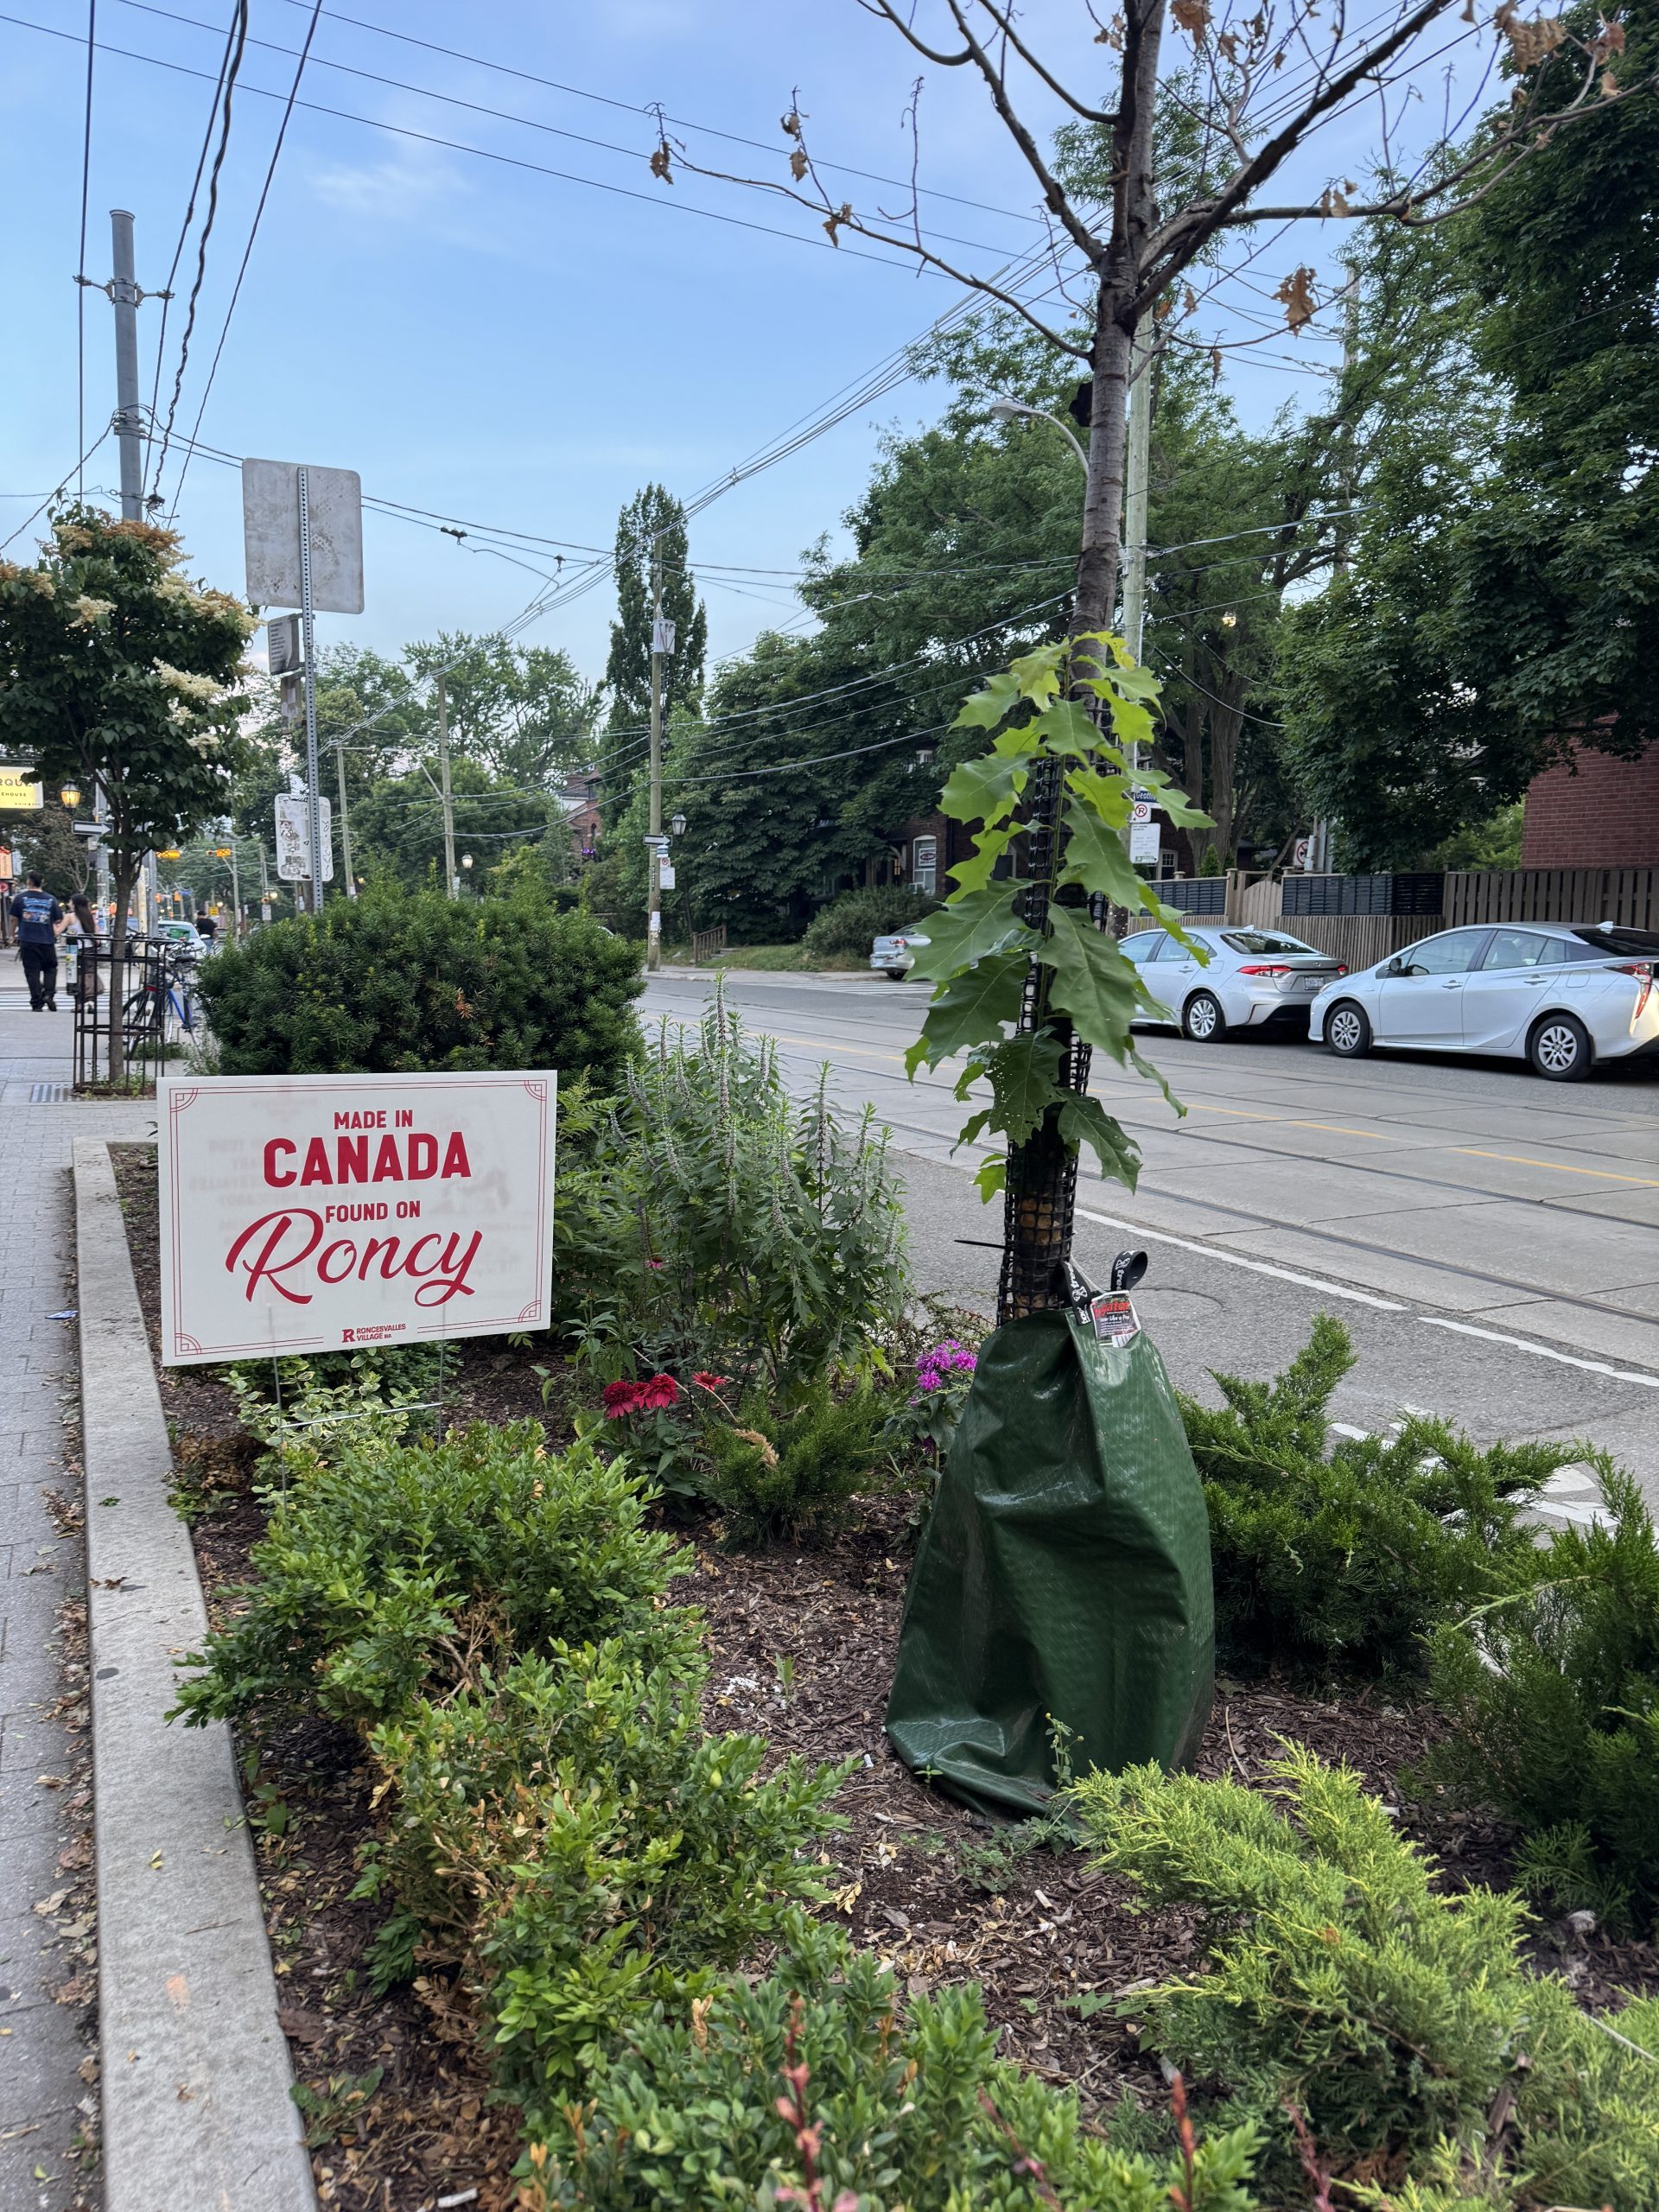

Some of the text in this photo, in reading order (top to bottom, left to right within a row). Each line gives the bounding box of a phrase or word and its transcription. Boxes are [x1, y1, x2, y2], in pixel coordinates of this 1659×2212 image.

[334, 1109, 413, 1129] MADE IN
[264, 1131, 471, 1188] CANADA
[325, 1202, 420, 1223] FOUND ON
[225, 1208, 483, 1307] Roncy
[356, 1323, 406, 1334] RONCESVALLES
